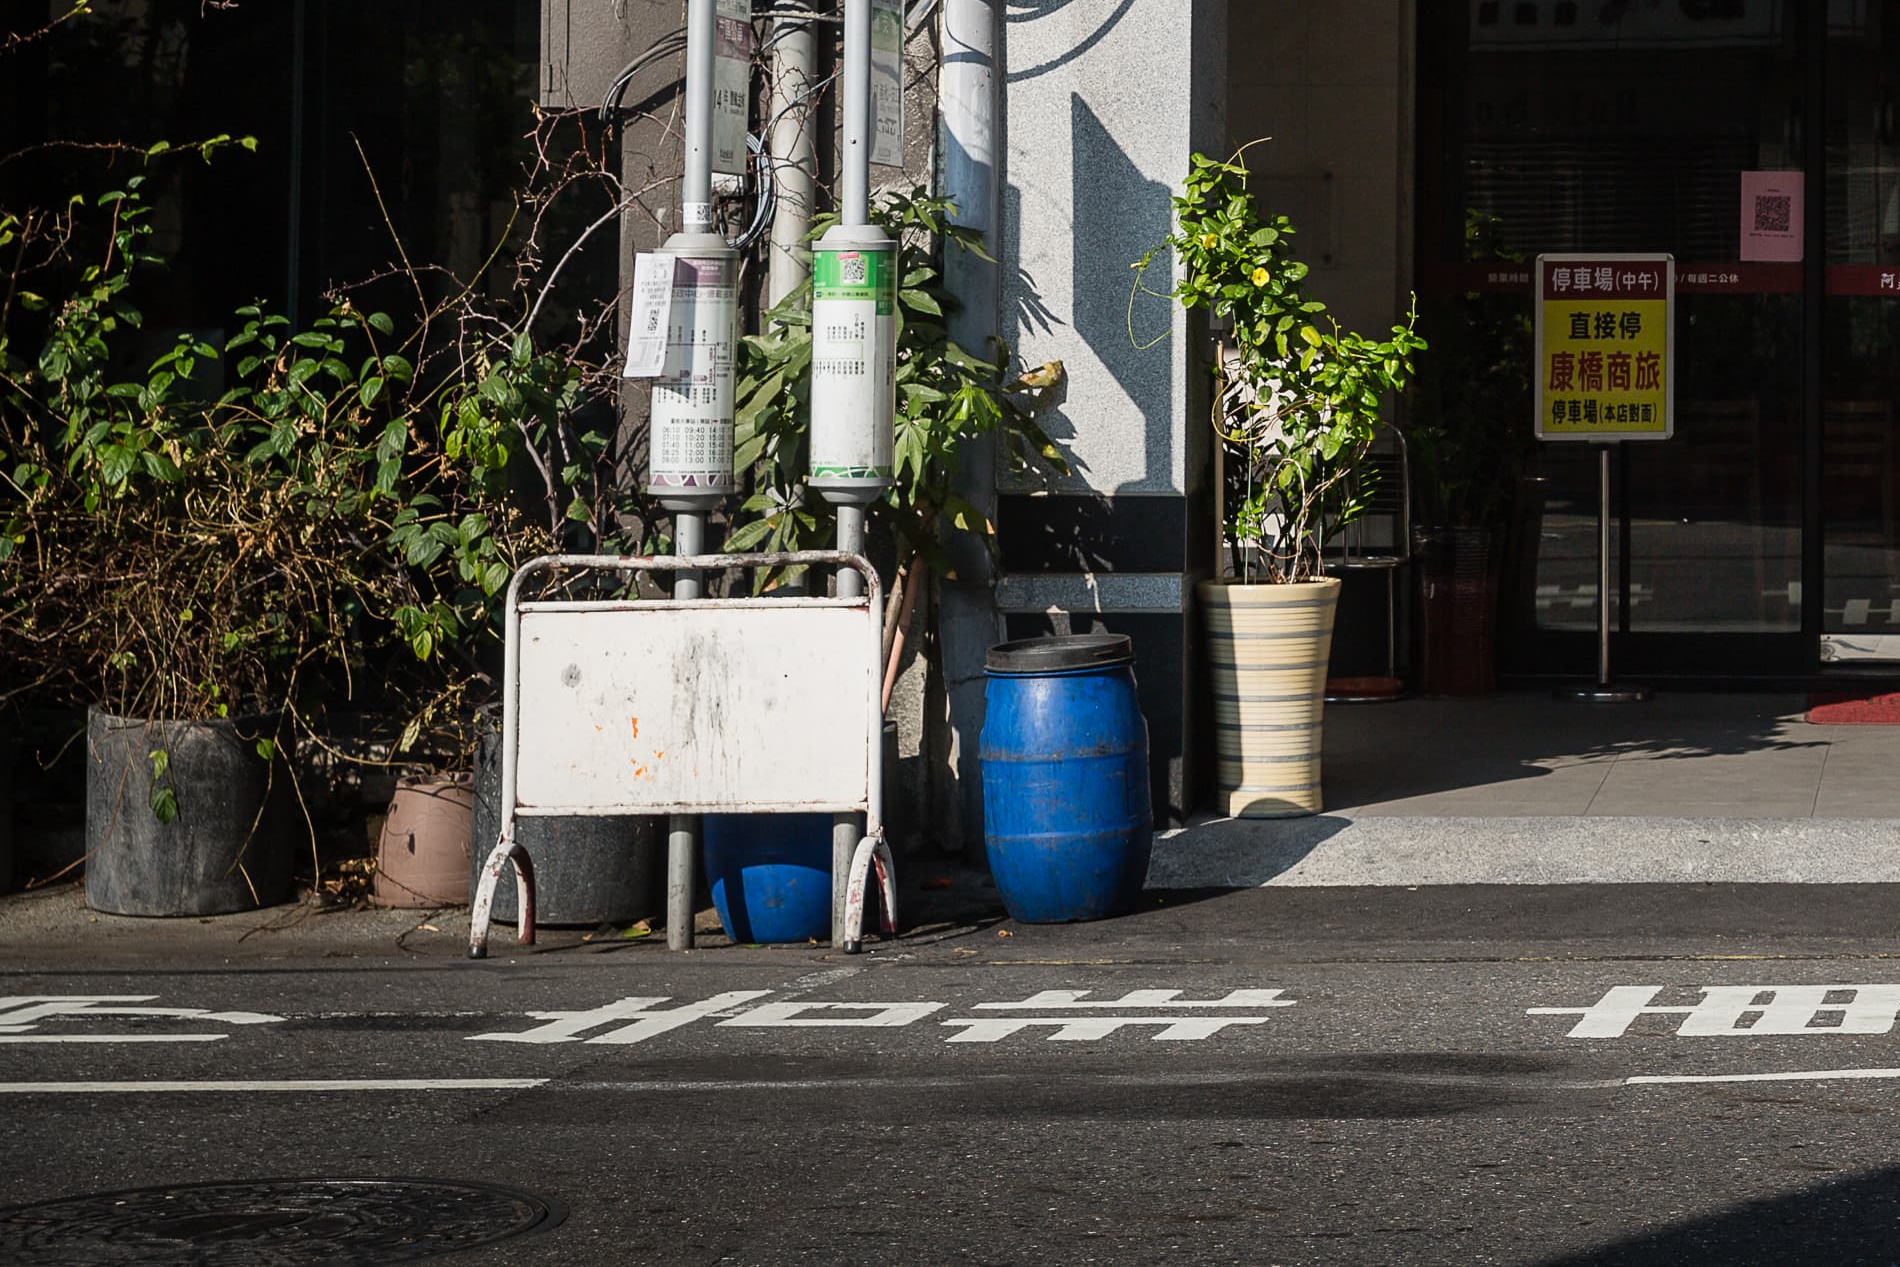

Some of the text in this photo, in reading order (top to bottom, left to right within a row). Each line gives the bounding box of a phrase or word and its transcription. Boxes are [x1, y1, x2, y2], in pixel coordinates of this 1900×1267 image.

[1551, 266, 1659, 292] 停車場(中午)
[1687, 272, 1740, 285] 每週二公休
[1569, 312, 1642, 340] 直接停
[1549, 350, 1661, 391] 康橋商旅
[1552, 399, 1657, 424] 停車場(本店對面)
